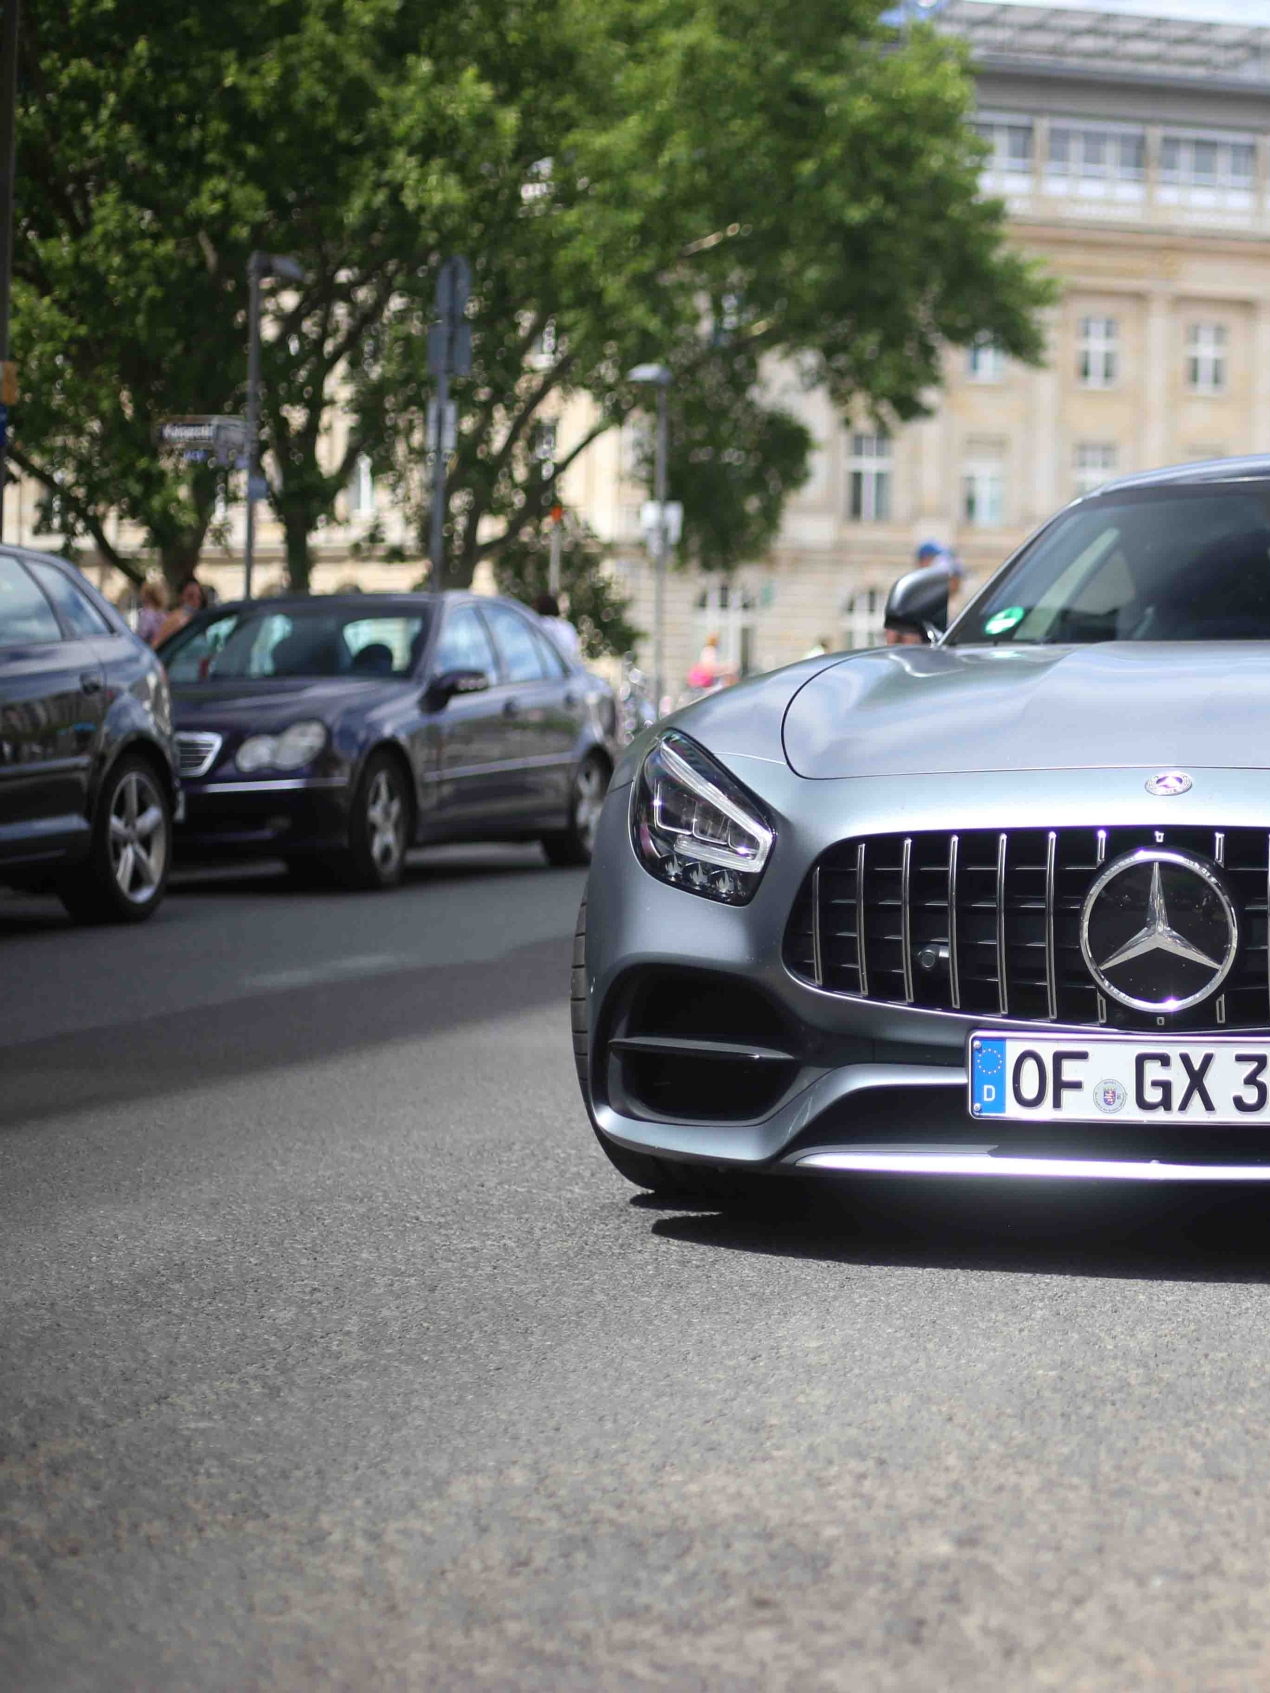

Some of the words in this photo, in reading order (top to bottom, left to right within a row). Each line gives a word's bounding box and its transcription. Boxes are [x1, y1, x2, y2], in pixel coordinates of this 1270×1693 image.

[983, 1084, 996, 1102] D
[1012, 1050, 1089, 1109] OF
[1136, 1053, 1216, 1112] GX
